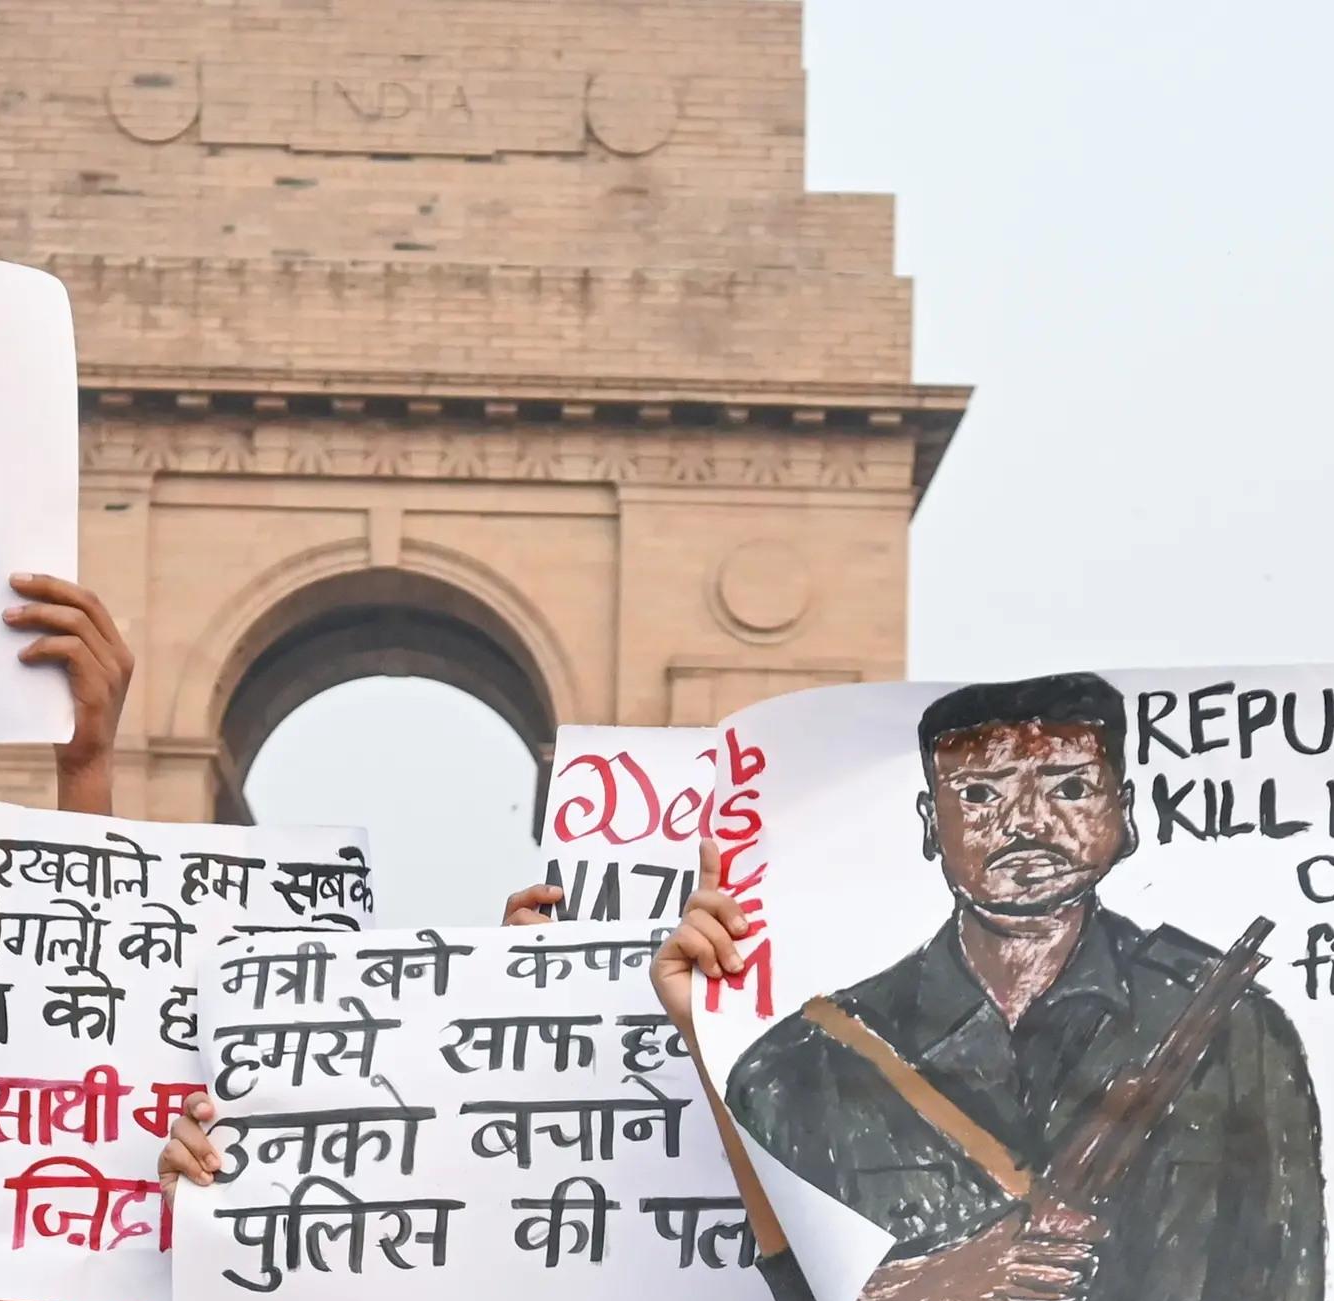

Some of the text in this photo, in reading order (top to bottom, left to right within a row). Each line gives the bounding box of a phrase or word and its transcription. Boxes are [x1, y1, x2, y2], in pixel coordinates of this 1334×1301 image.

[311, 80, 473, 122] INDIA
[1151, 773, 1312, 845] KILL
[179, 852, 265, 905] हम
[119, 900, 197, 969] को
[357, 930, 475, 1000] बने
[43, 966, 126, 1046] को
[213, 997, 401, 1101] हमसे
[205, 1074, 693, 1183] उनको बचाने
[214, 1175, 465, 1293] पुलिस
[512, 1175, 620, 1267] की
